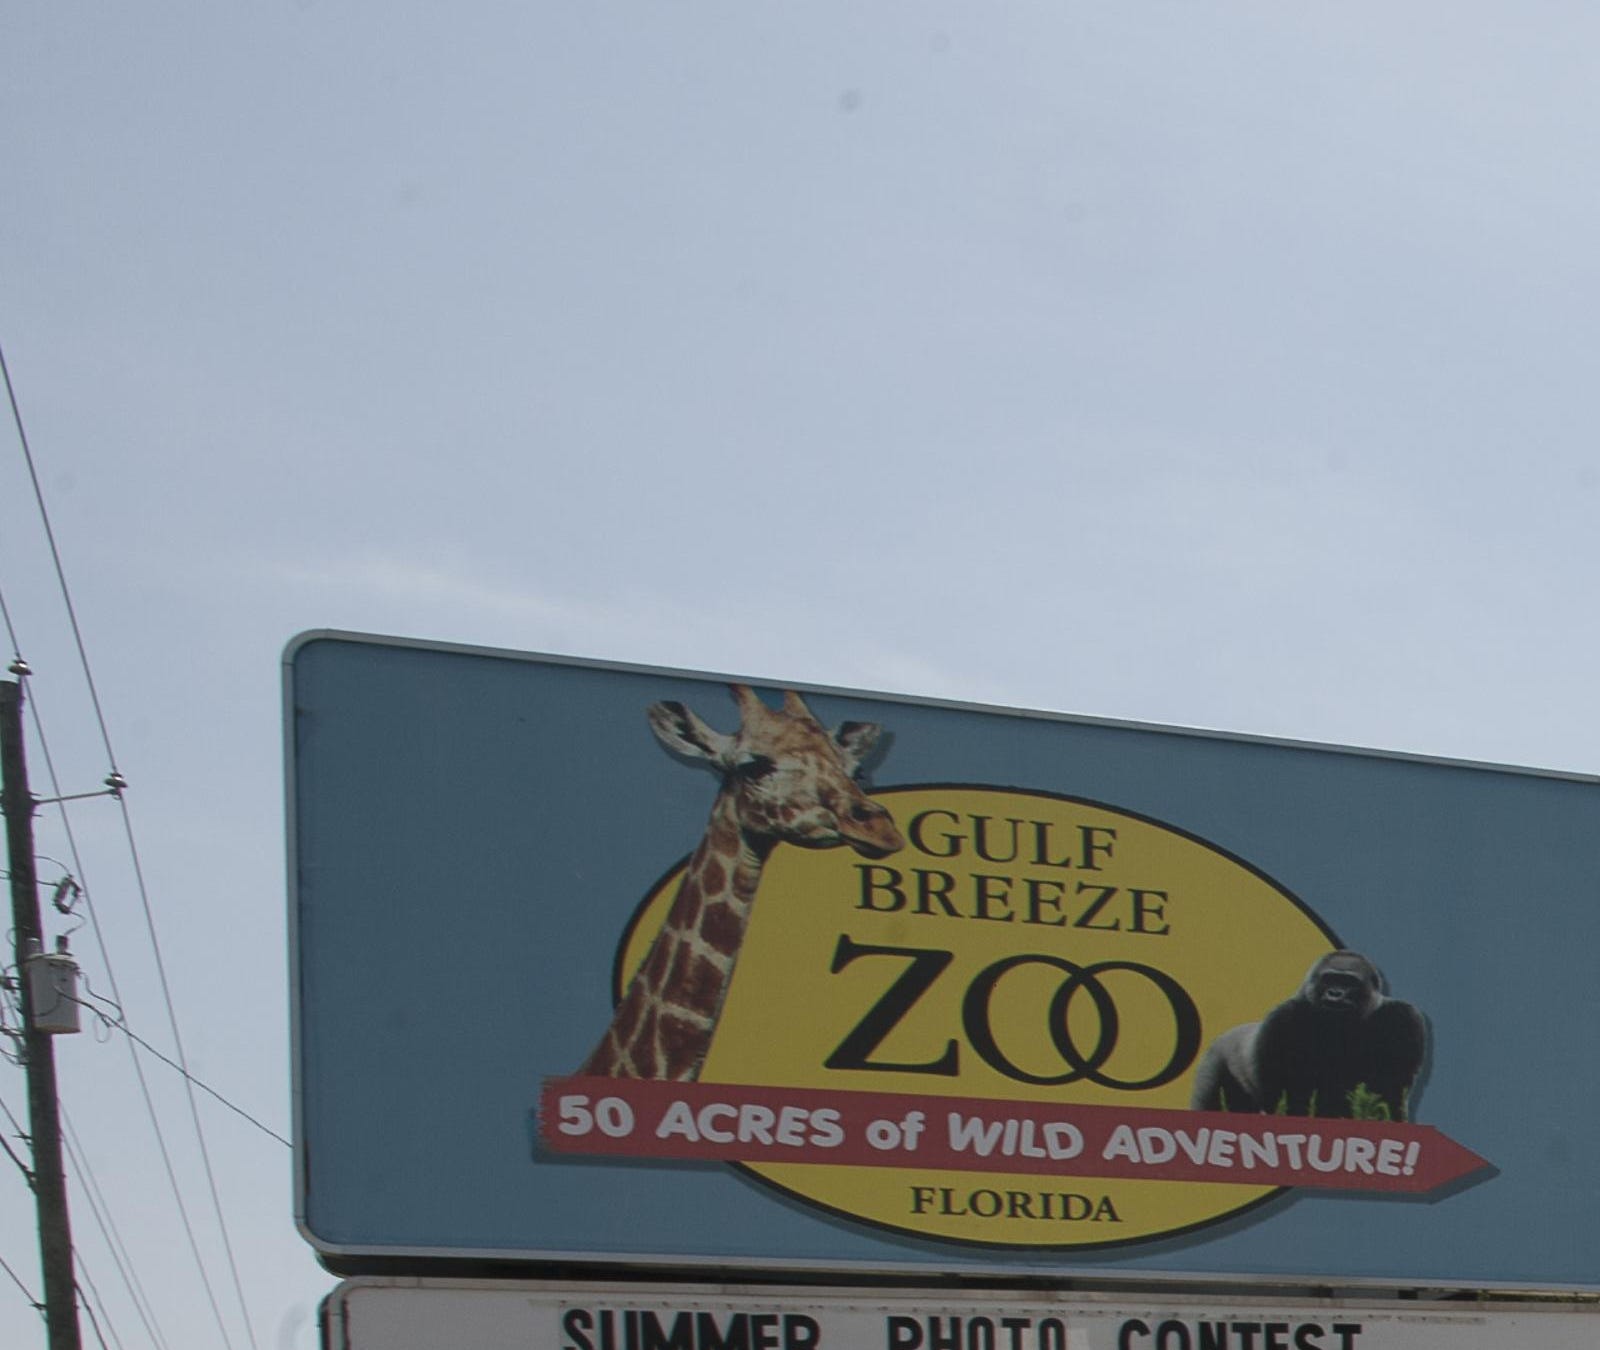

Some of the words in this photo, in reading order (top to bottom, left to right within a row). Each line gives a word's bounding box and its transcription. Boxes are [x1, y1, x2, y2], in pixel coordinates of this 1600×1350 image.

[909, 809, 1118, 871] GULF
[852, 863, 1170, 935] BREEZE
[824, 933, 1203, 1091] ZOO
[558, 1094, 635, 1138] 50
[655, 1100, 845, 1148] ACRES
[866, 1111, 926, 1152] of
[948, 1112, 1084, 1160] WILD
[1102, 1125, 1421, 1175] ADVENTURE!
[909, 1186, 1123, 1223] FLORIDA
